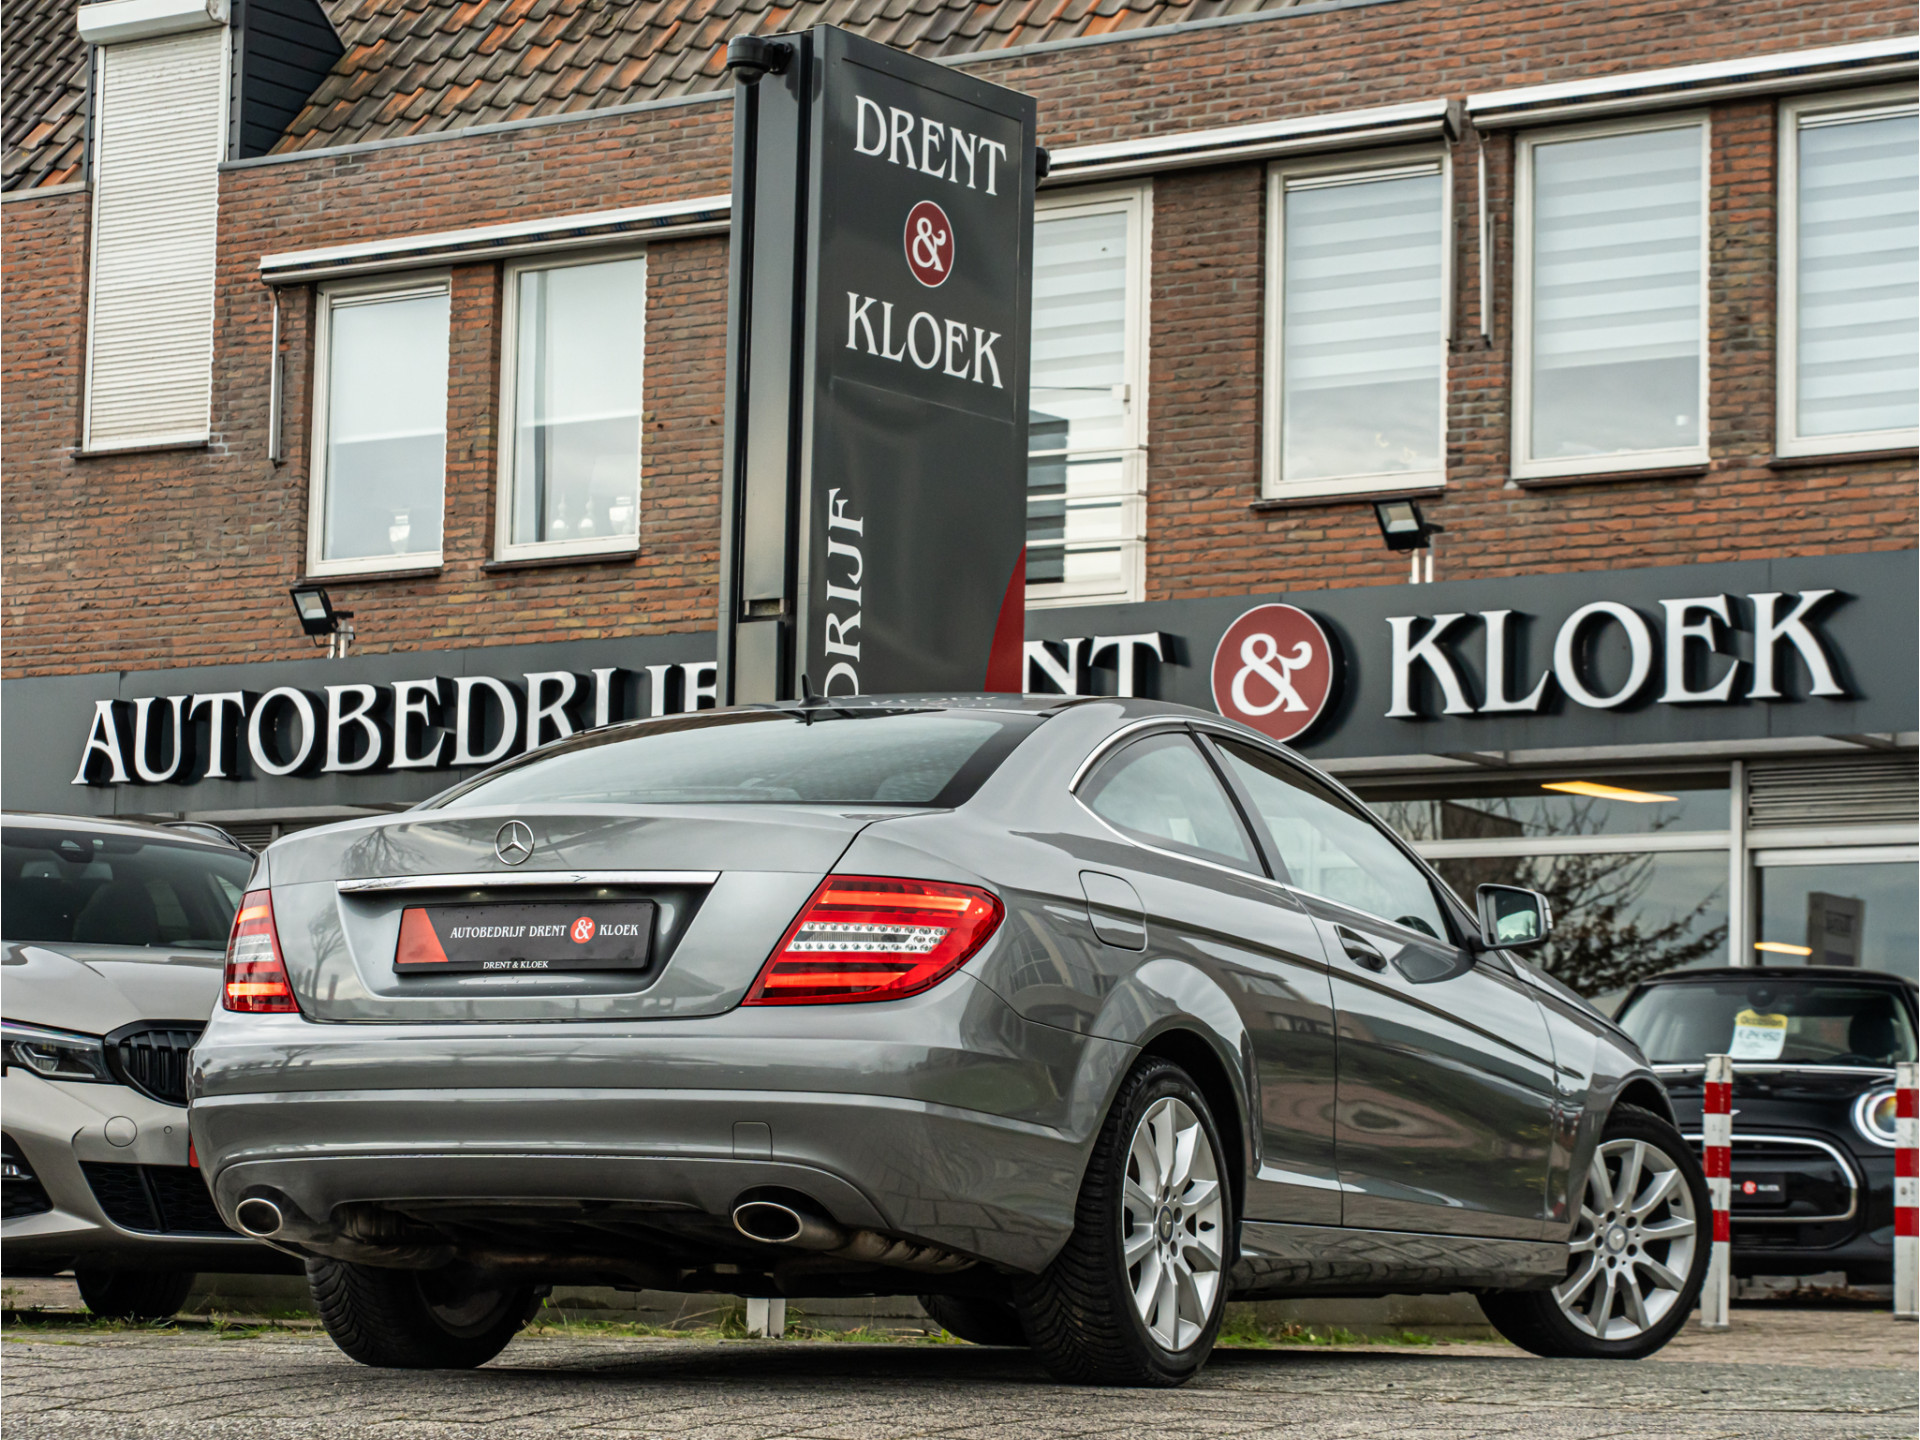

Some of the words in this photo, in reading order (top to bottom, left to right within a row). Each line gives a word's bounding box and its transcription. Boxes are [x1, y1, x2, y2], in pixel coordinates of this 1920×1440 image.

[854, 95, 1006, 196] DRENT
[912, 216, 946, 272] &
[845, 290, 1003, 389] KLOEK
[1231, 632, 1313, 717] &
[1385, 589, 1845, 718] KLOEK
[450, 925, 526, 939] AUTOBEDRIJF
[529, 924, 567, 937] DRENT
[574, 919, 593, 940] &
[599, 924, 639, 936] KLOEK
[483, 961, 512, 969] DRENT
[512, 961, 518, 969] &
[520, 960, 549, 969] KLOEK
